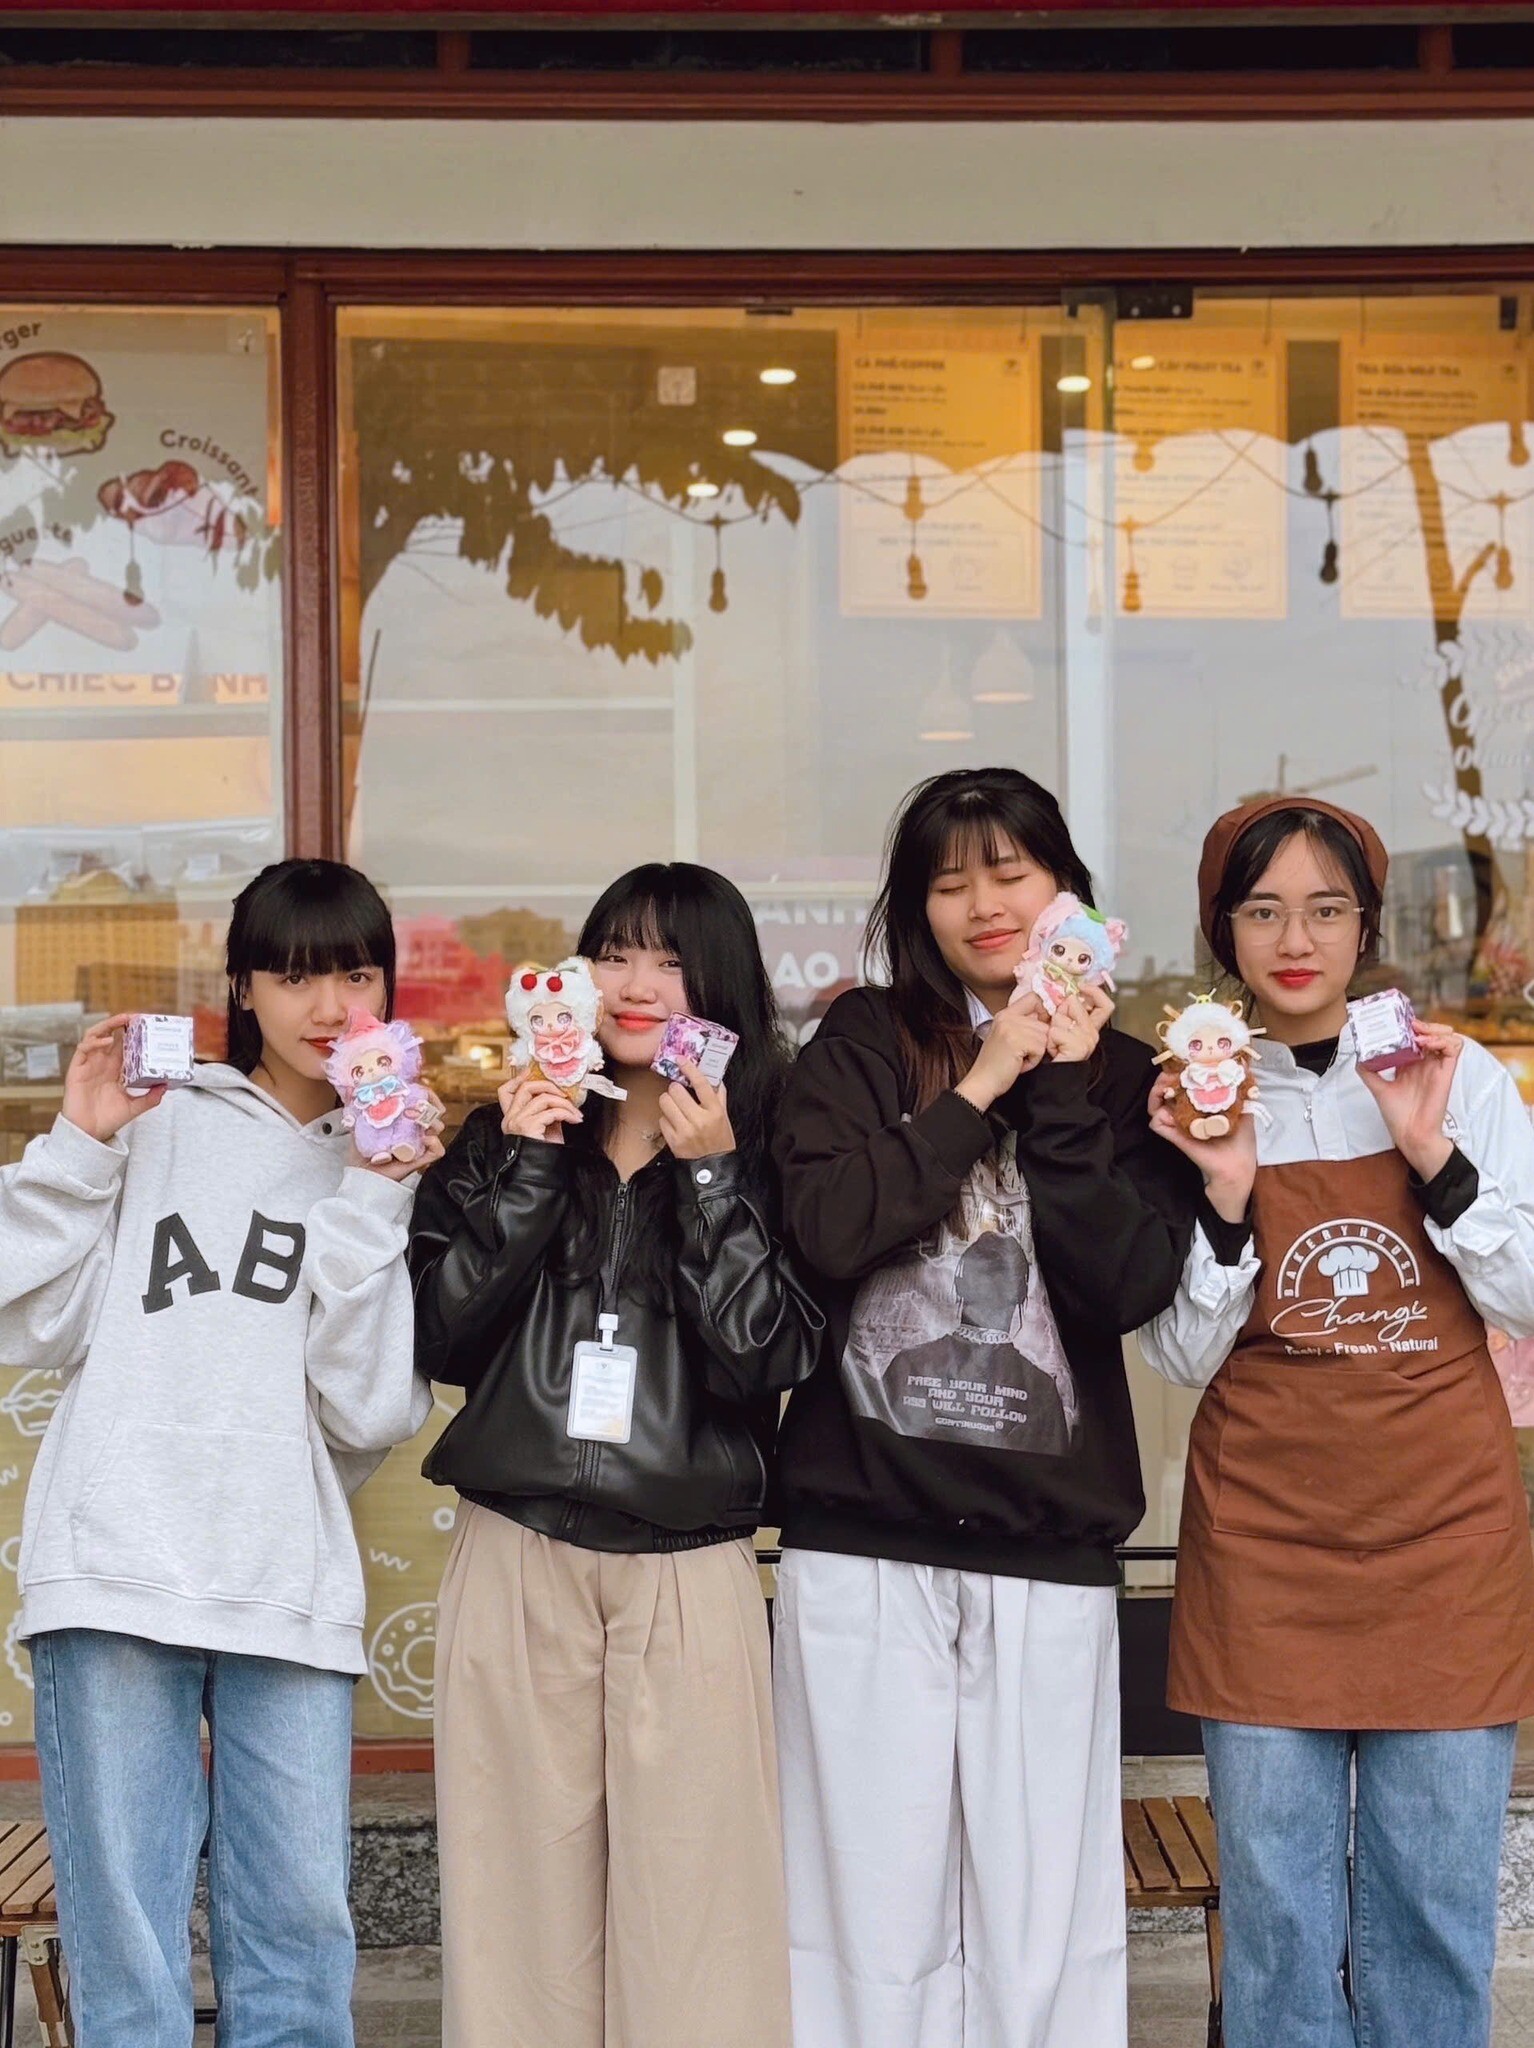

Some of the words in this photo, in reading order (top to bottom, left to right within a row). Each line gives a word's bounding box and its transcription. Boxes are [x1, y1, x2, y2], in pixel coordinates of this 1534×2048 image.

[160, 429, 259, 496] Croissant
[770, 951, 840, 989] AO
[1270, 1296, 1428, 1342] Changi
[1334, 1342, 1378, 1356] Fresh
[1389, 1336, 1438, 1353] Natural
